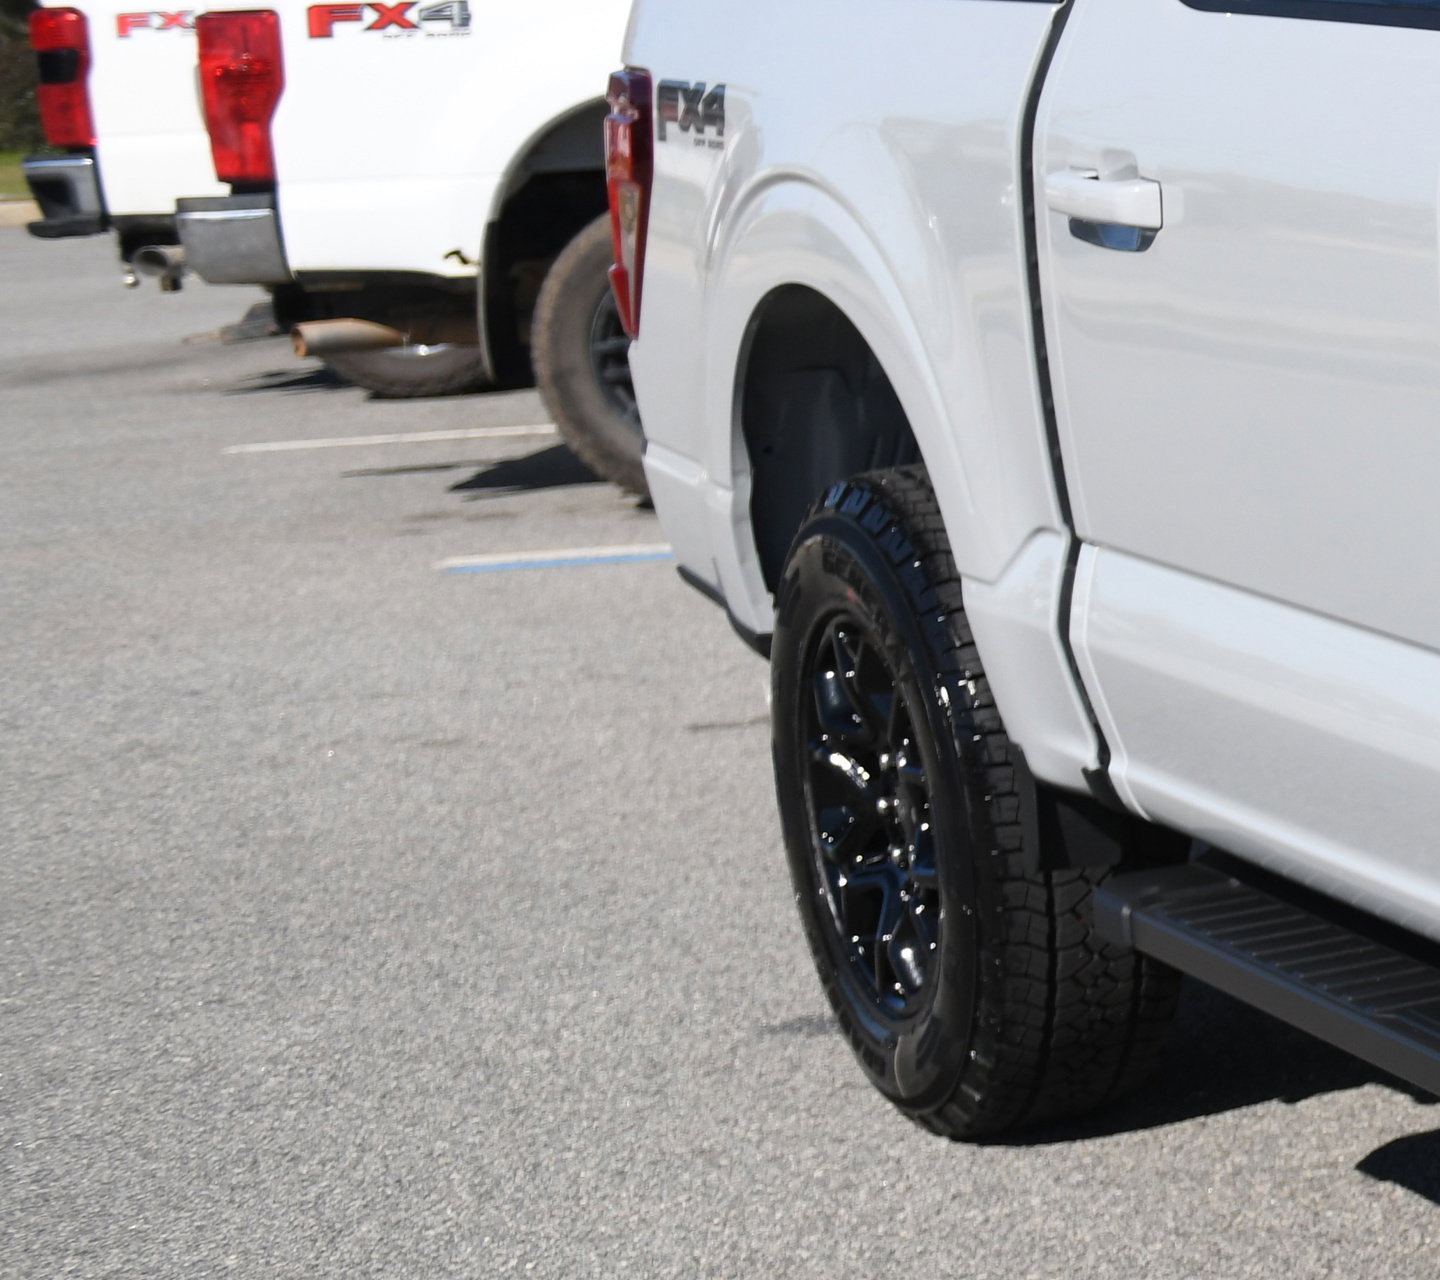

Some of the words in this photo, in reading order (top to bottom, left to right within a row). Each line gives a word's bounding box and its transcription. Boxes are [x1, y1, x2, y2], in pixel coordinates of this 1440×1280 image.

[116, 10, 196, 38] FX
[307, 0, 472, 38] FX4
[657, 79, 726, 142] FX4
